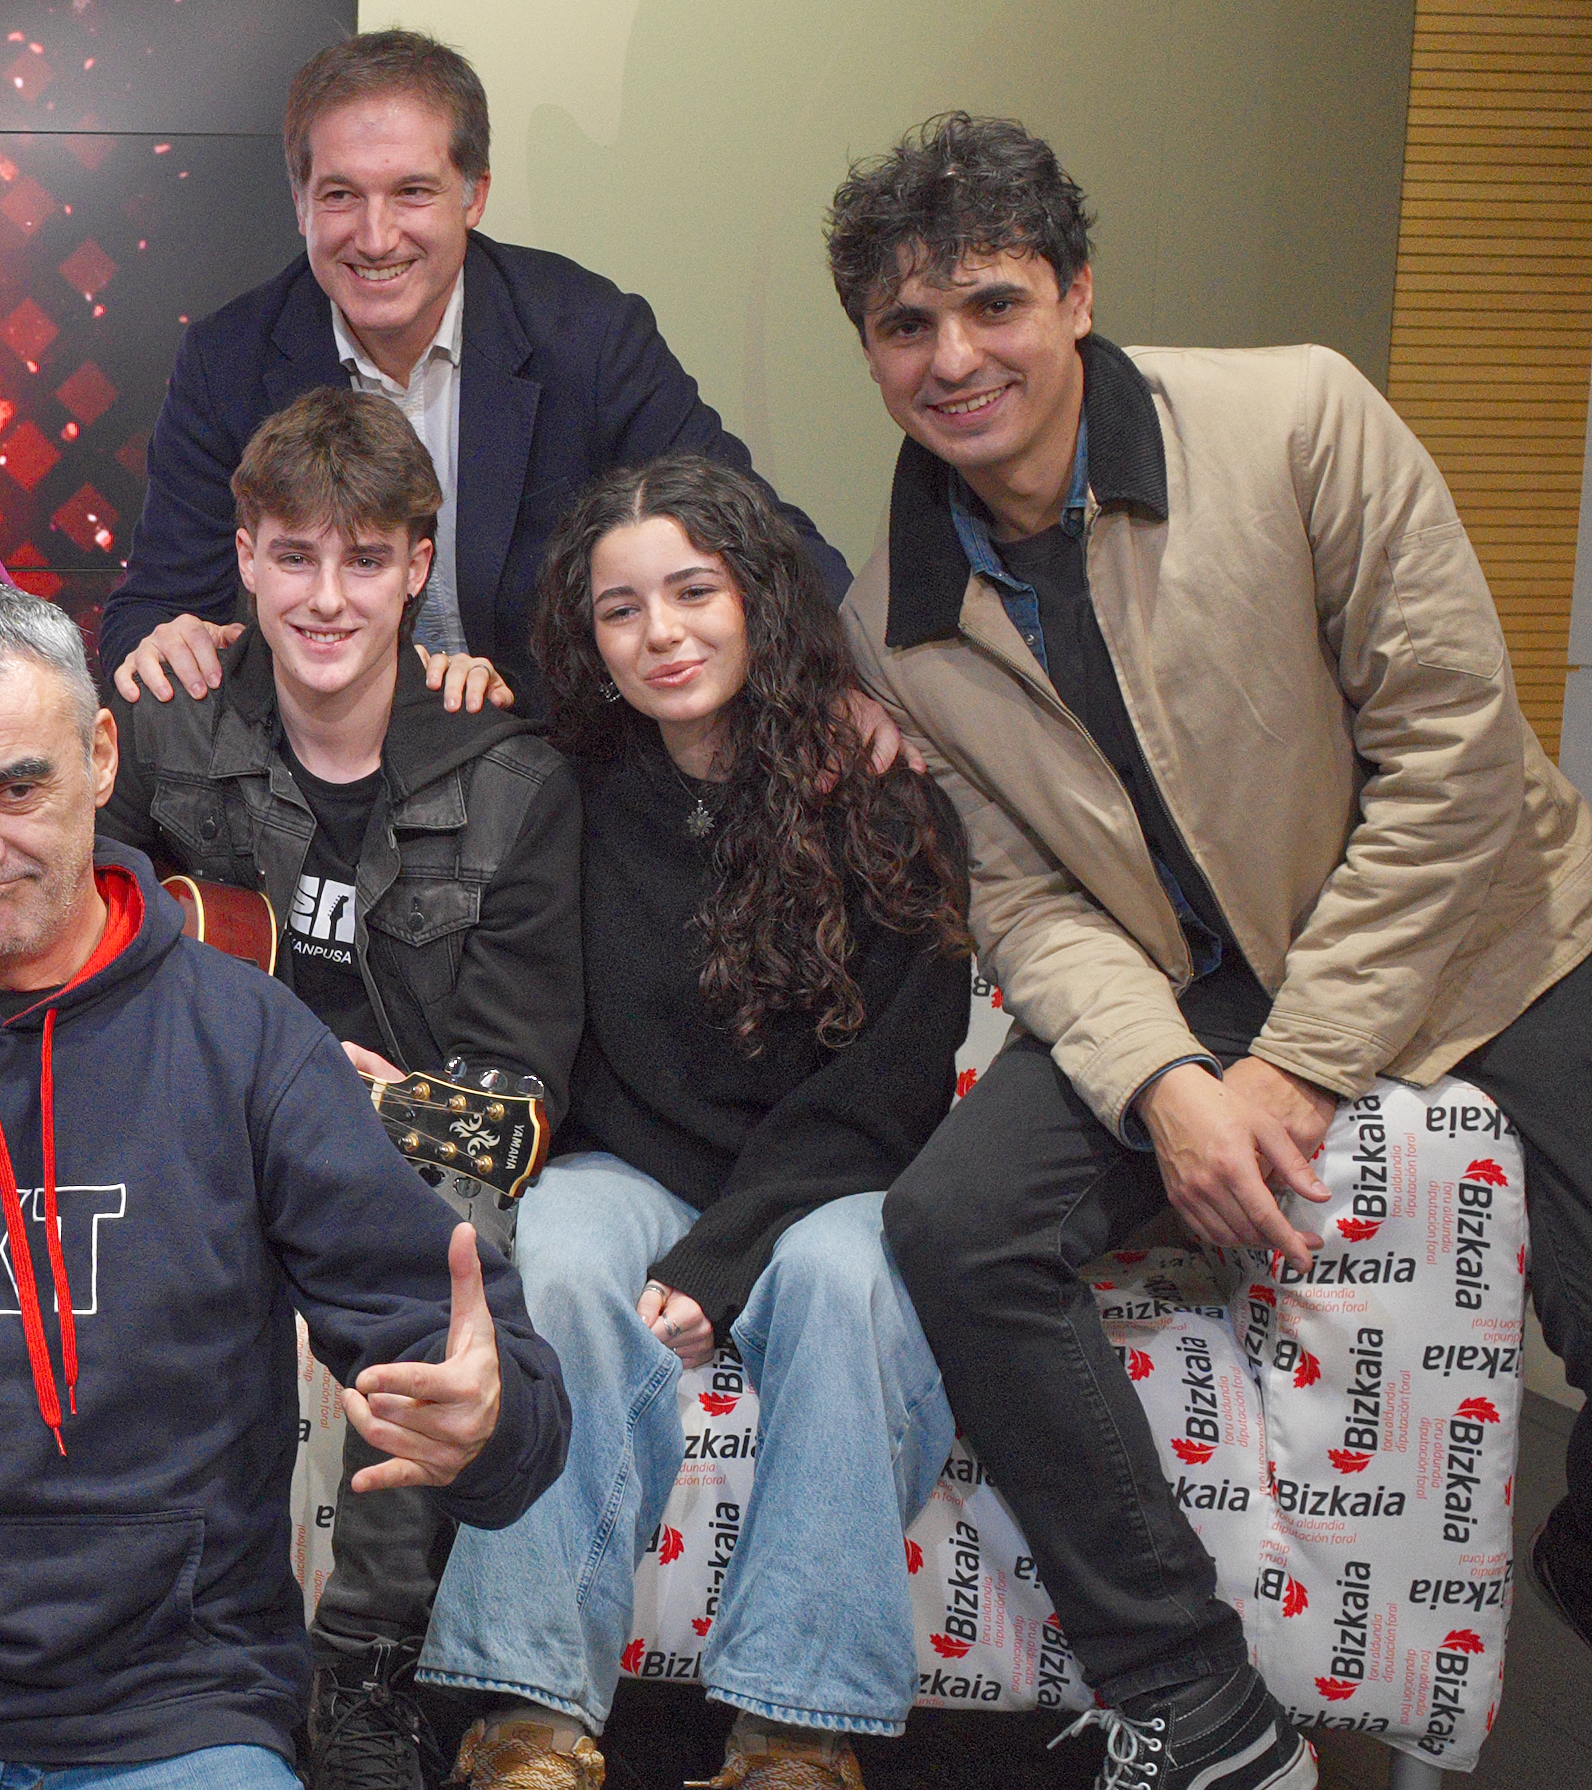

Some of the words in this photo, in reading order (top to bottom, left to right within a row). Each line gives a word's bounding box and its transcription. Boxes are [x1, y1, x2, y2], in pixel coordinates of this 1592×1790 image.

[505, 1124, 525, 1170] YAMAHA
[1349, 1094, 1388, 1218] Bizkaia
[1404, 1132, 1418, 1158] foral
[1390, 1145, 1402, 1193] aldundia
[1390, 1194, 1402, 1218] foru
[1442, 1181, 1455, 1205] foru
[1442, 1206, 1454, 1254] aldundia
[1455, 1182, 1493, 1311] Bizkaia
[1426, 1239, 1439, 1265] foral
[1282, 1295, 1340, 1313] diputación
[1341, 1301, 1368, 1314] foral
[1305, 1287, 1355, 1299] aldundia
[1176, 1337, 1220, 1443] Bizkaia
[1344, 1327, 1384, 1451] Bizkaia
[1399, 1370, 1412, 1396] foral
[1382, 1382, 1396, 1428] aldundia
[1381, 1429, 1394, 1452] foru
[1433, 1417, 1446, 1441] foru
[701, 1475, 726, 1486] foral
[1431, 1442, 1444, 1489] aldundia
[1443, 1419, 1484, 1543] Bizkaia
[1169, 1476, 1250, 1512] kaia
[1277, 1479, 1406, 1517] Bizkaia
[1416, 1474, 1428, 1500] foral
[1271, 1520, 1329, 1543] diputación
[1330, 1532, 1357, 1545] foral
[1296, 1518, 1346, 1531] aldundia
[945, 1521, 979, 1642] Bizkaia
[1330, 1561, 1371, 1680] Bizkaia
[1386, 1602, 1398, 1627] foral
[1369, 1613, 1383, 1657] aldundia
[919, 1669, 1002, 1701] zkaia
[1367, 1657, 1380, 1682] foru
[1417, 1651, 1469, 1756] Bizkaia
